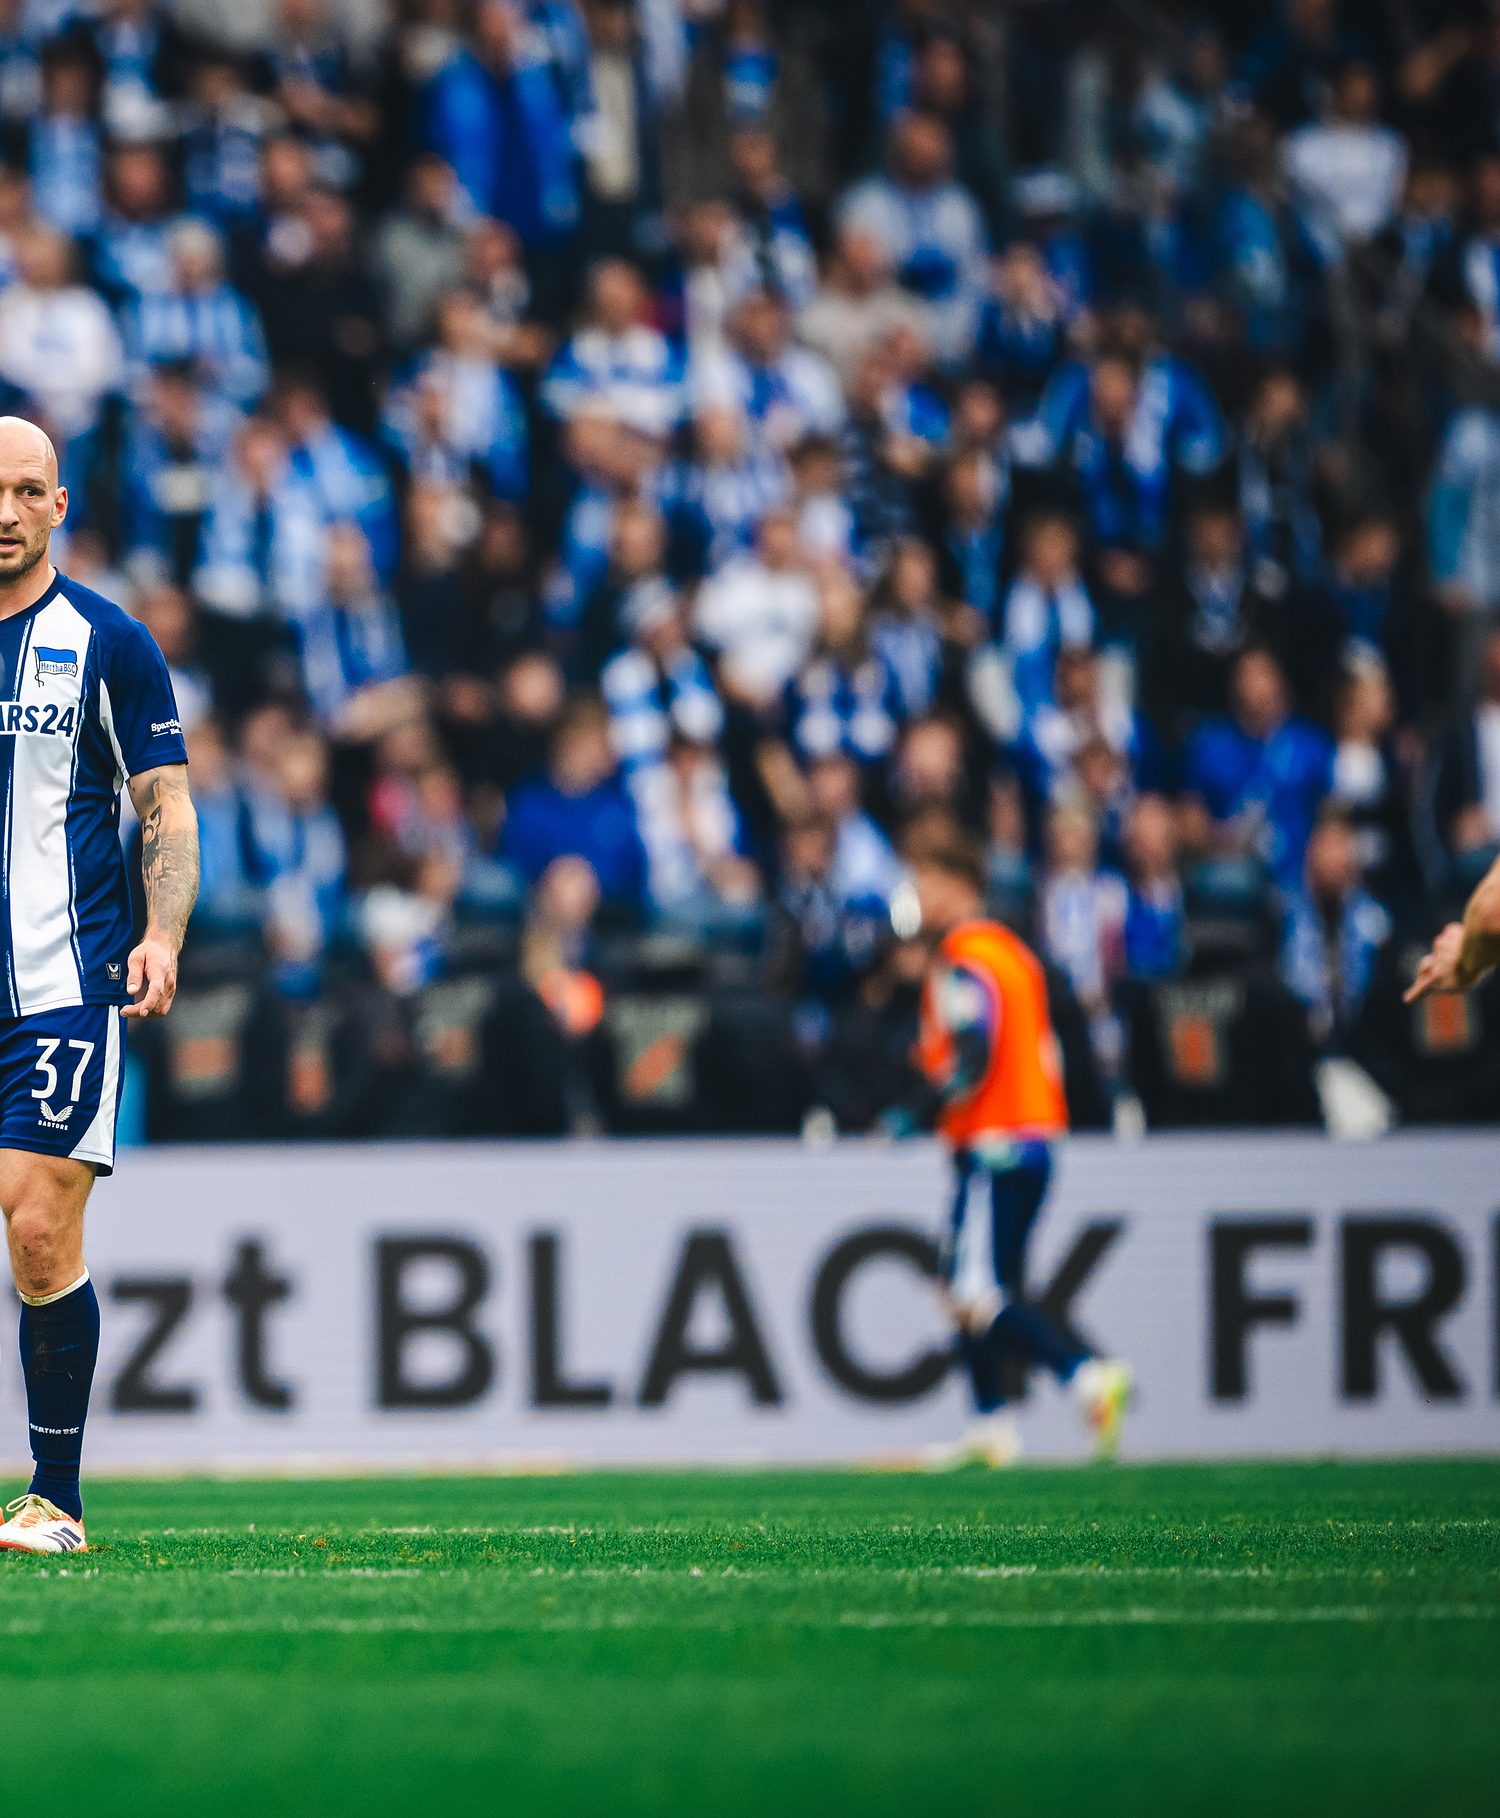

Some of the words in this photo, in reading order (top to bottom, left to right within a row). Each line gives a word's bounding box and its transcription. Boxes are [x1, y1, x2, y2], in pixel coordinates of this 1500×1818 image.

[40, 662, 63, 673] Hertha
[63, 663, 76, 674] BSC
[31, 1038, 95, 1102] 37
[37, 1119, 69, 1131] CASTORE
[62, 1426, 80, 1435] BSC
